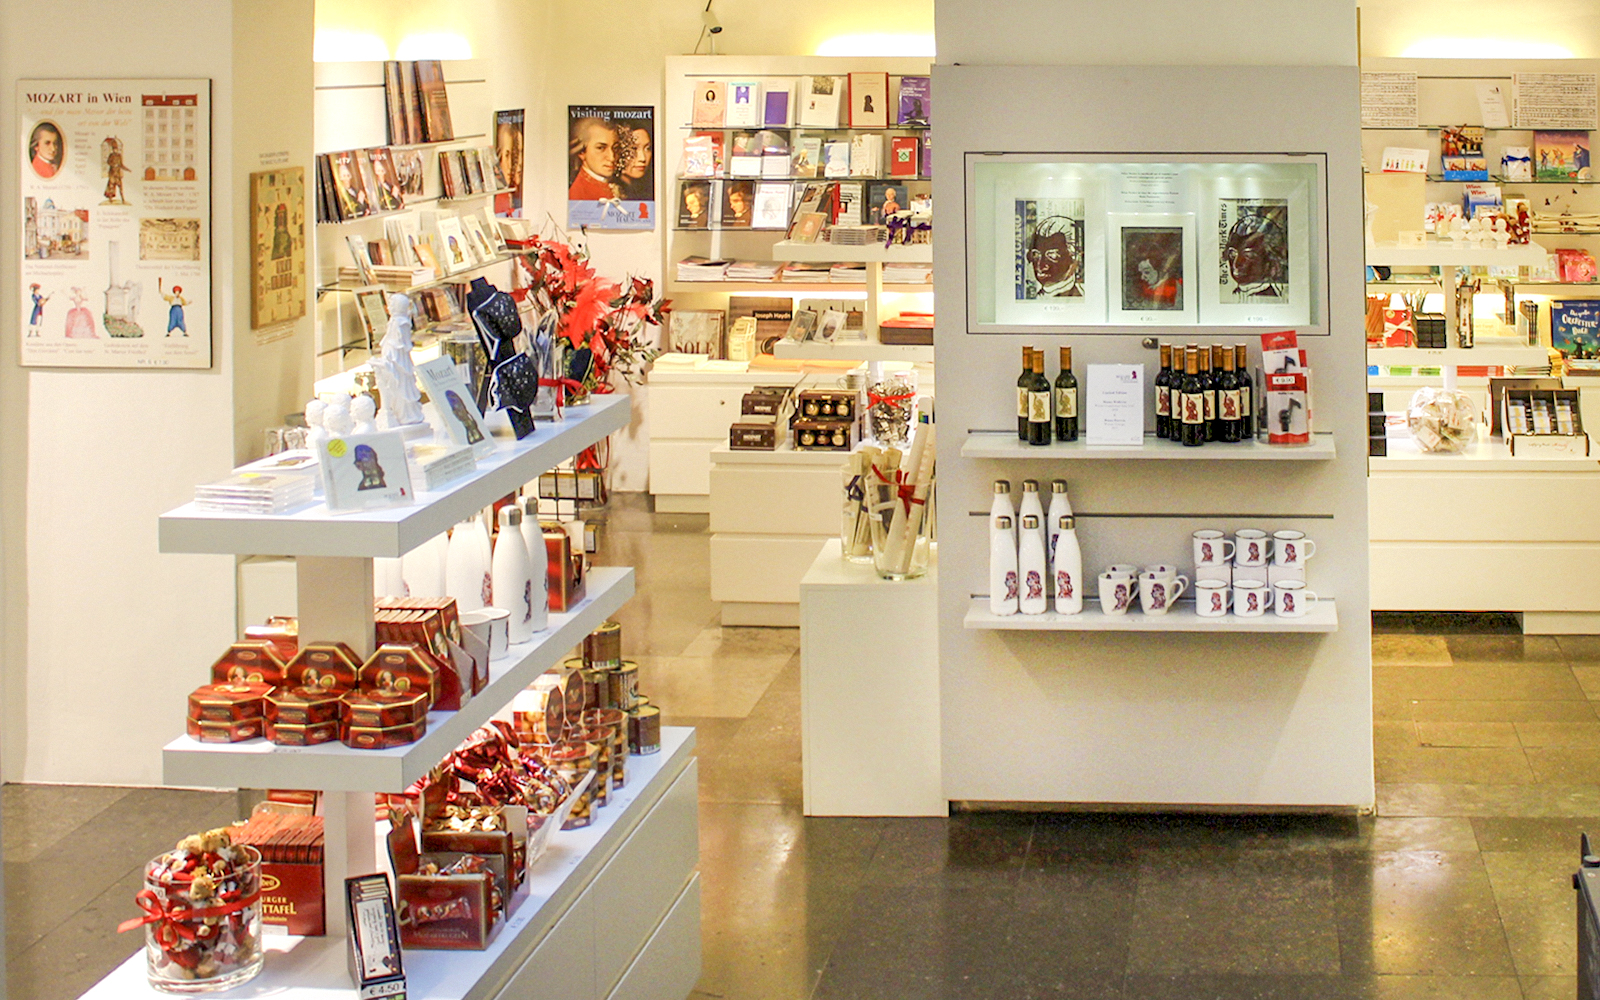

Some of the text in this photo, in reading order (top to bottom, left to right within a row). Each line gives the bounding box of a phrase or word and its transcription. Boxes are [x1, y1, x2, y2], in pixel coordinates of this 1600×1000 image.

[26, 93, 132, 103] MOZART in Wien
[570, 107, 653, 122] visiting mozart
[1218, 203, 1228, 228] Times
[1219, 270, 1229, 285] The
[773, 312, 791, 320] Haydn
[426, 365, 454, 381] Mozart
[262, 902, 298, 915] TTAFEL
[369, 982, 400, 996] € 4.50
